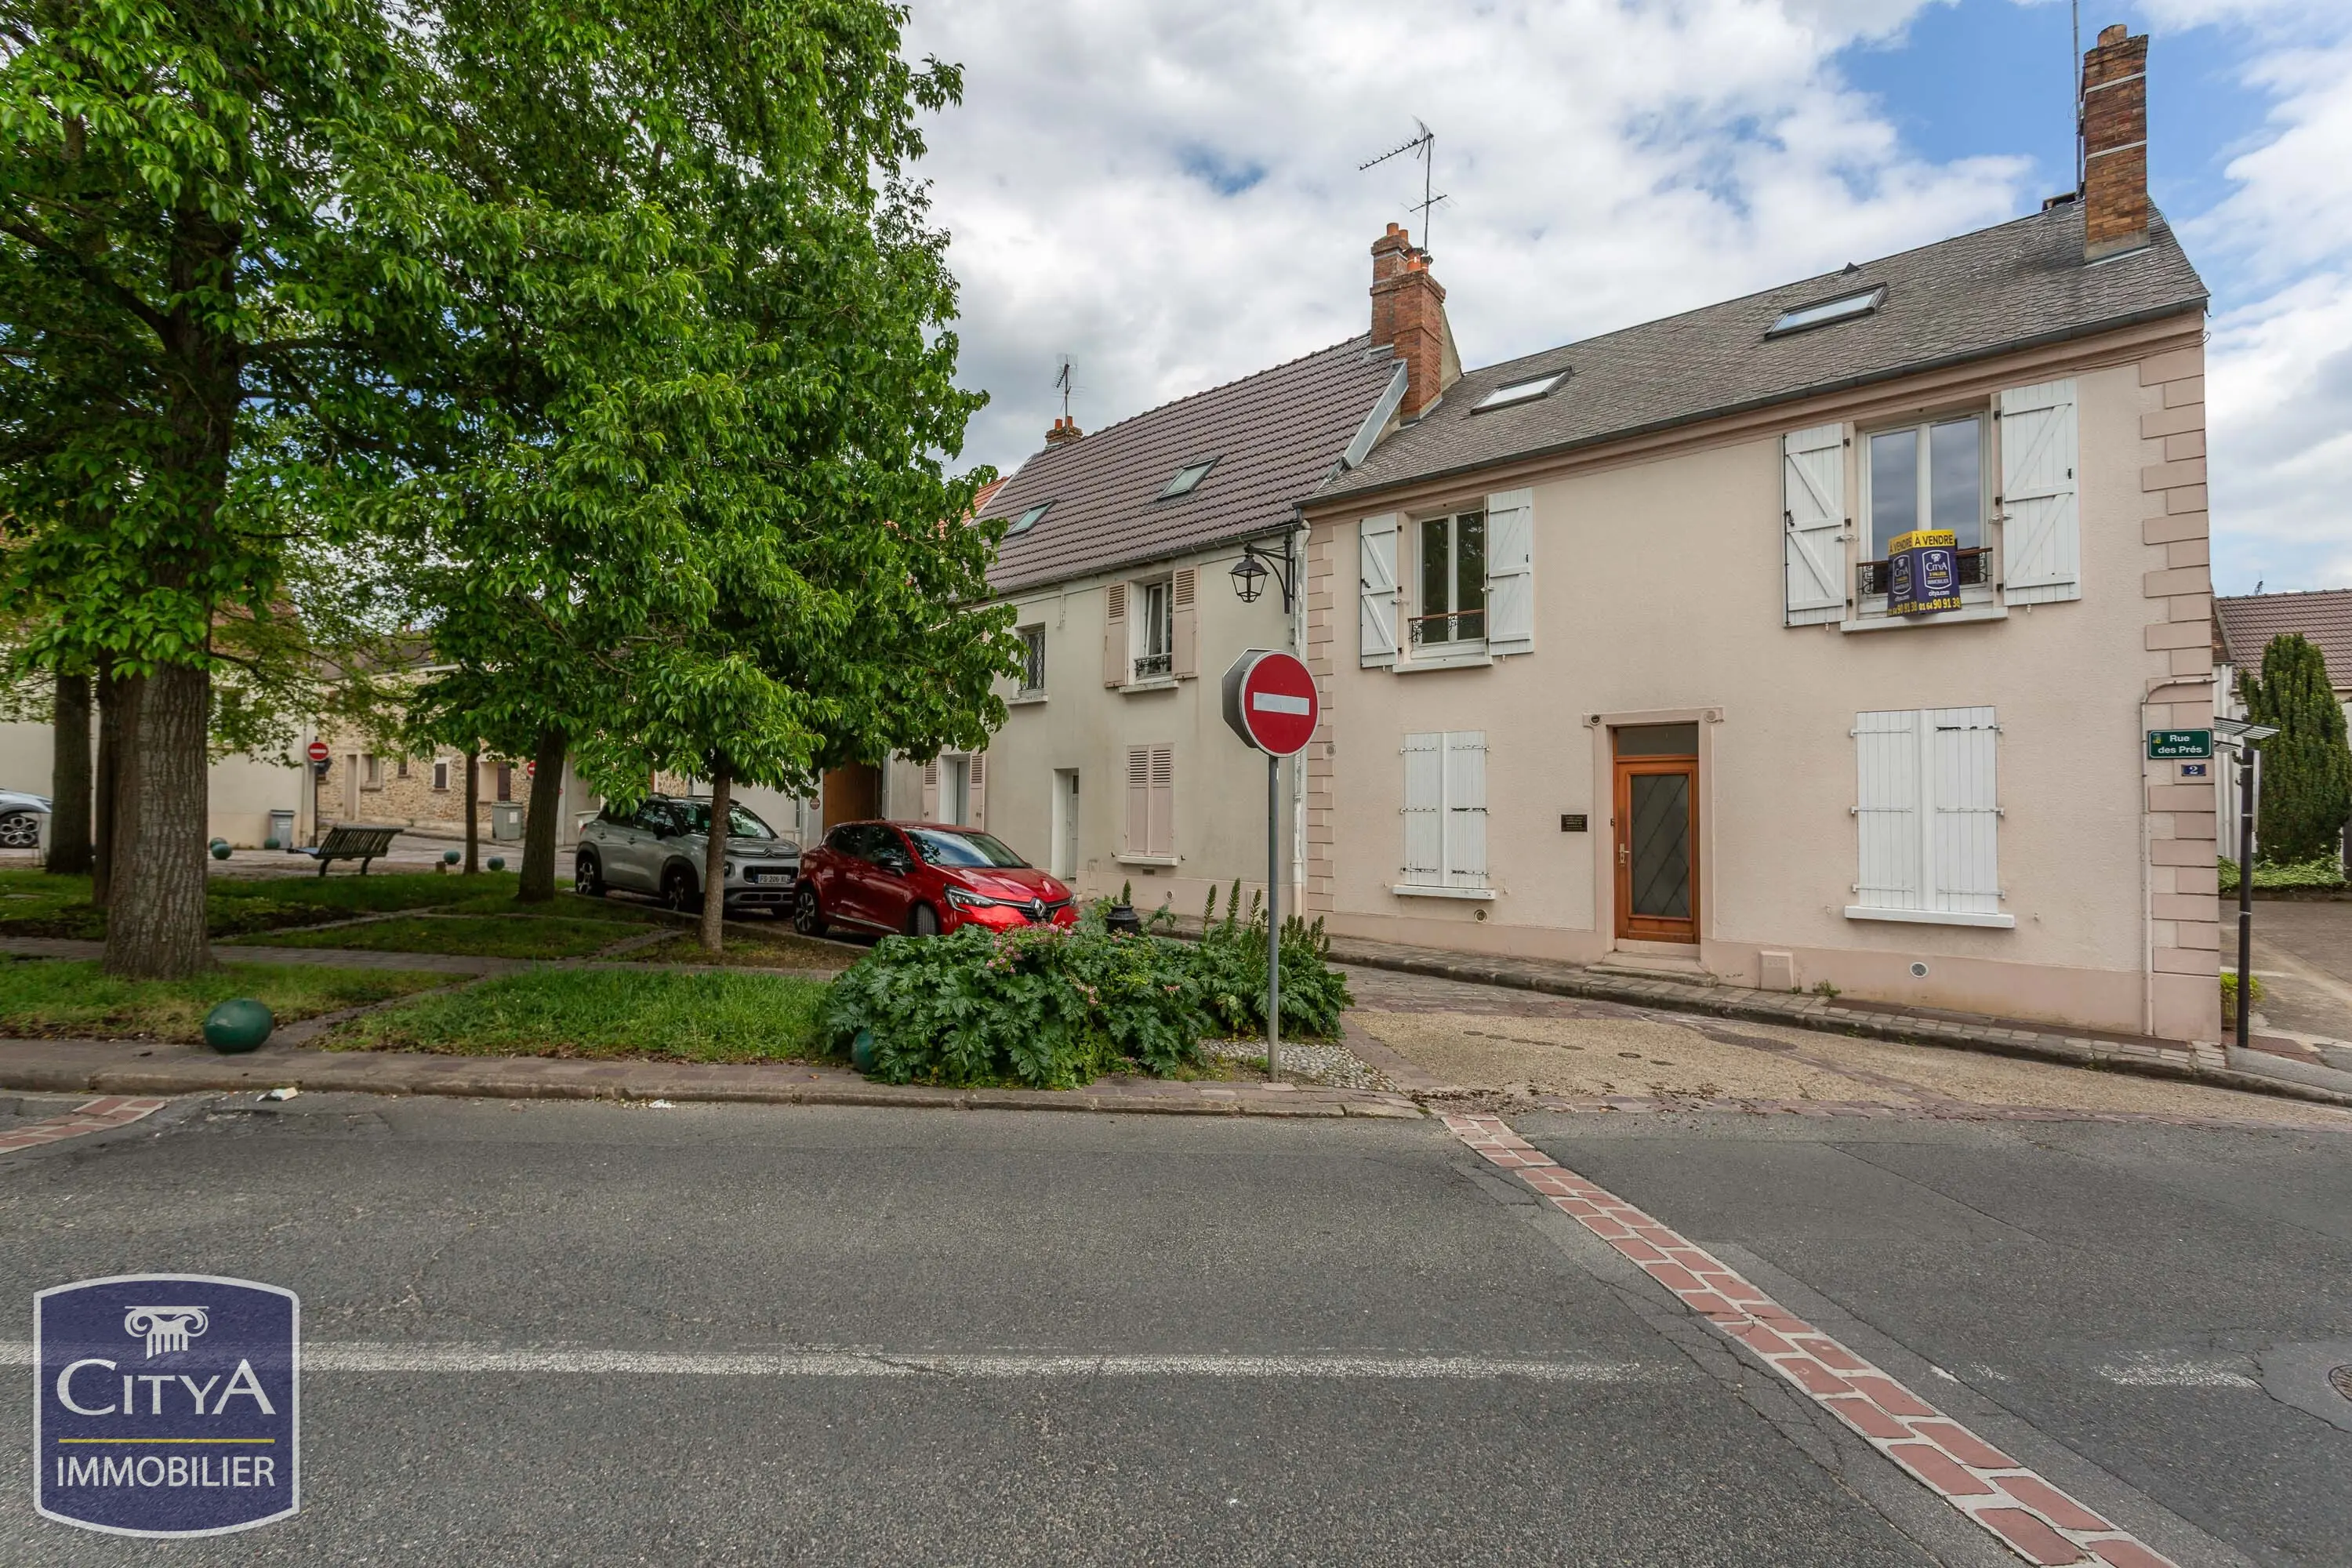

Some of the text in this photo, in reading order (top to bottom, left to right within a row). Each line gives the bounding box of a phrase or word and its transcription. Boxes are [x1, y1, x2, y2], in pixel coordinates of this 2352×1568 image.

[1915, 533, 1954, 546] À VENDRE
[1933, 598, 1942, 609] 90
[1943, 597, 1951, 608] 91
[2189, 765, 2198, 775] 2
